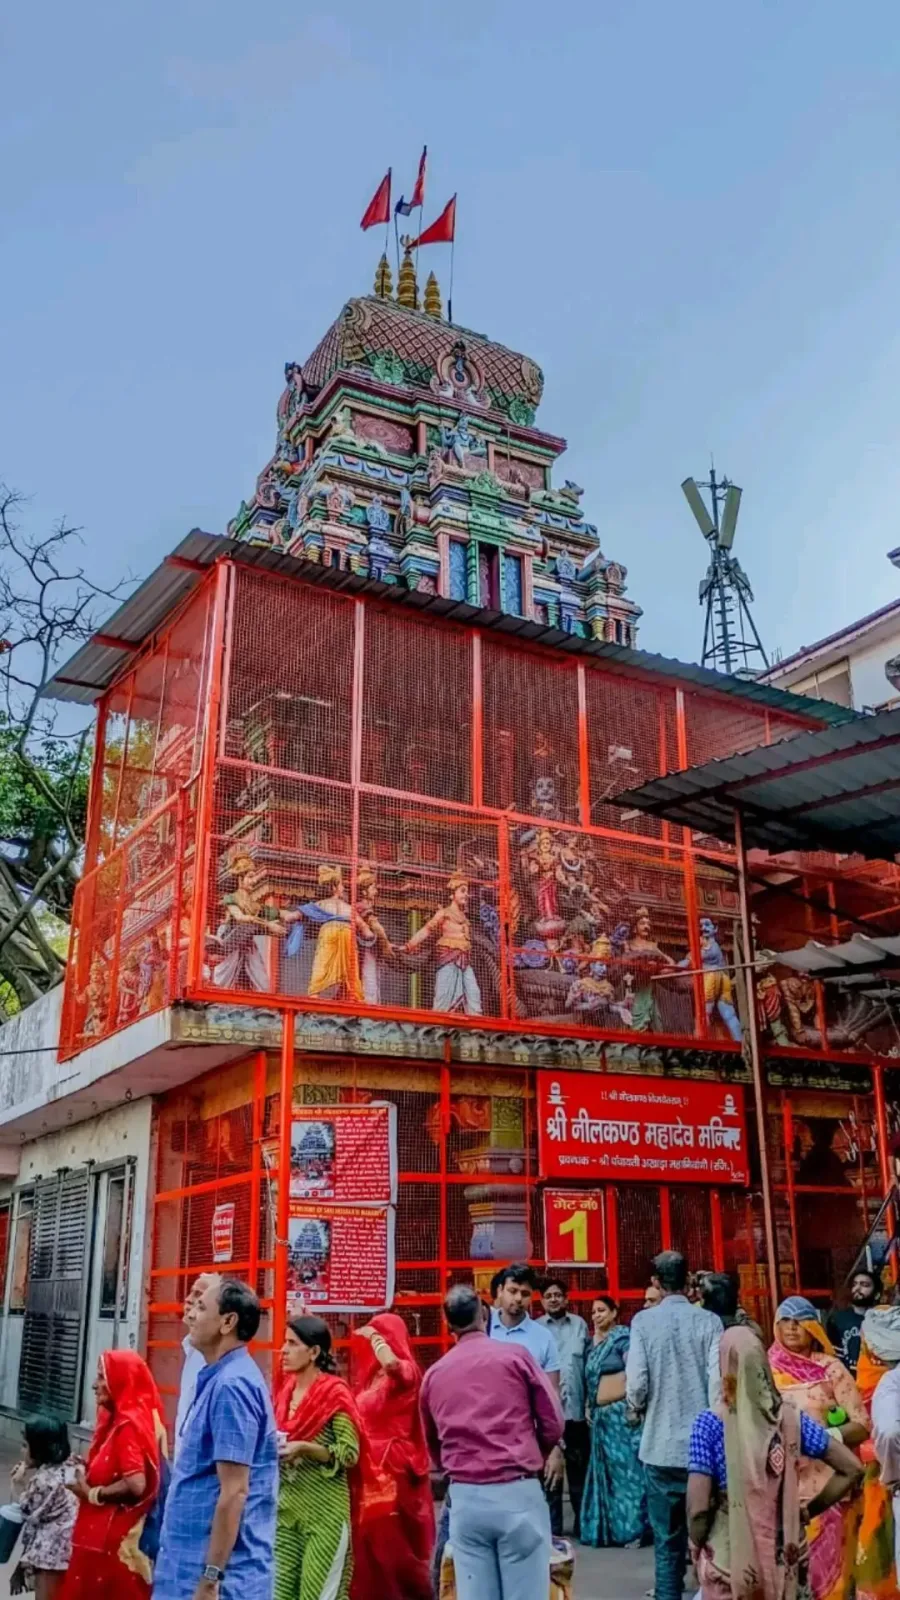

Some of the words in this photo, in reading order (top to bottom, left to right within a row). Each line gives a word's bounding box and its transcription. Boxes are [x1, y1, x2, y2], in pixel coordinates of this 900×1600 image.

[546, 1106, 567, 1142] श्री
[571, 1108, 640, 1146] नीलकण्ठ
[644, 1116, 694, 1150] महादेव
[599, 1153, 609, 1166] श्री
[559, 1210, 588, 1262] 1
